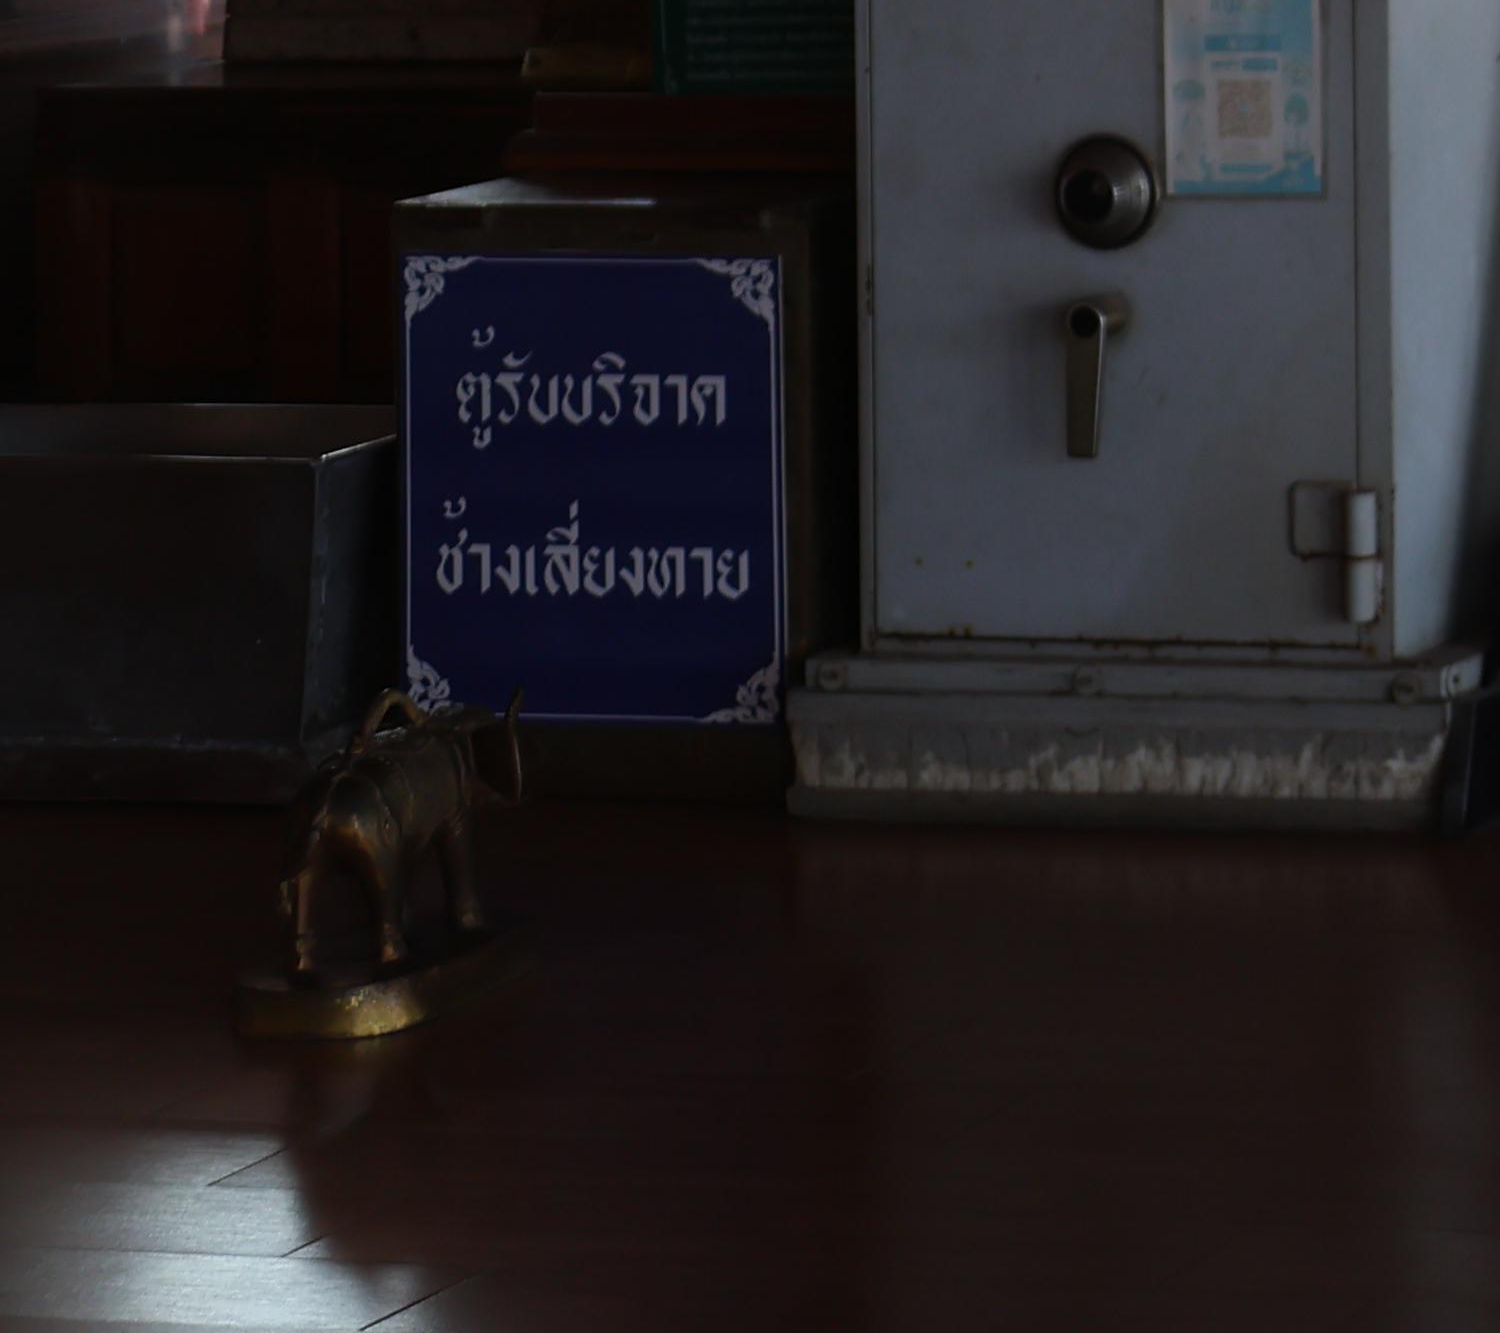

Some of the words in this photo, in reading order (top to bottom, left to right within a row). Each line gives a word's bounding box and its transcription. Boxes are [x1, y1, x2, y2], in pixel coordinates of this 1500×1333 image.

[454, 323, 728, 452] ตู้รับบริจาค
[433, 495, 753, 600] ช้างเสี่ยงทาย
